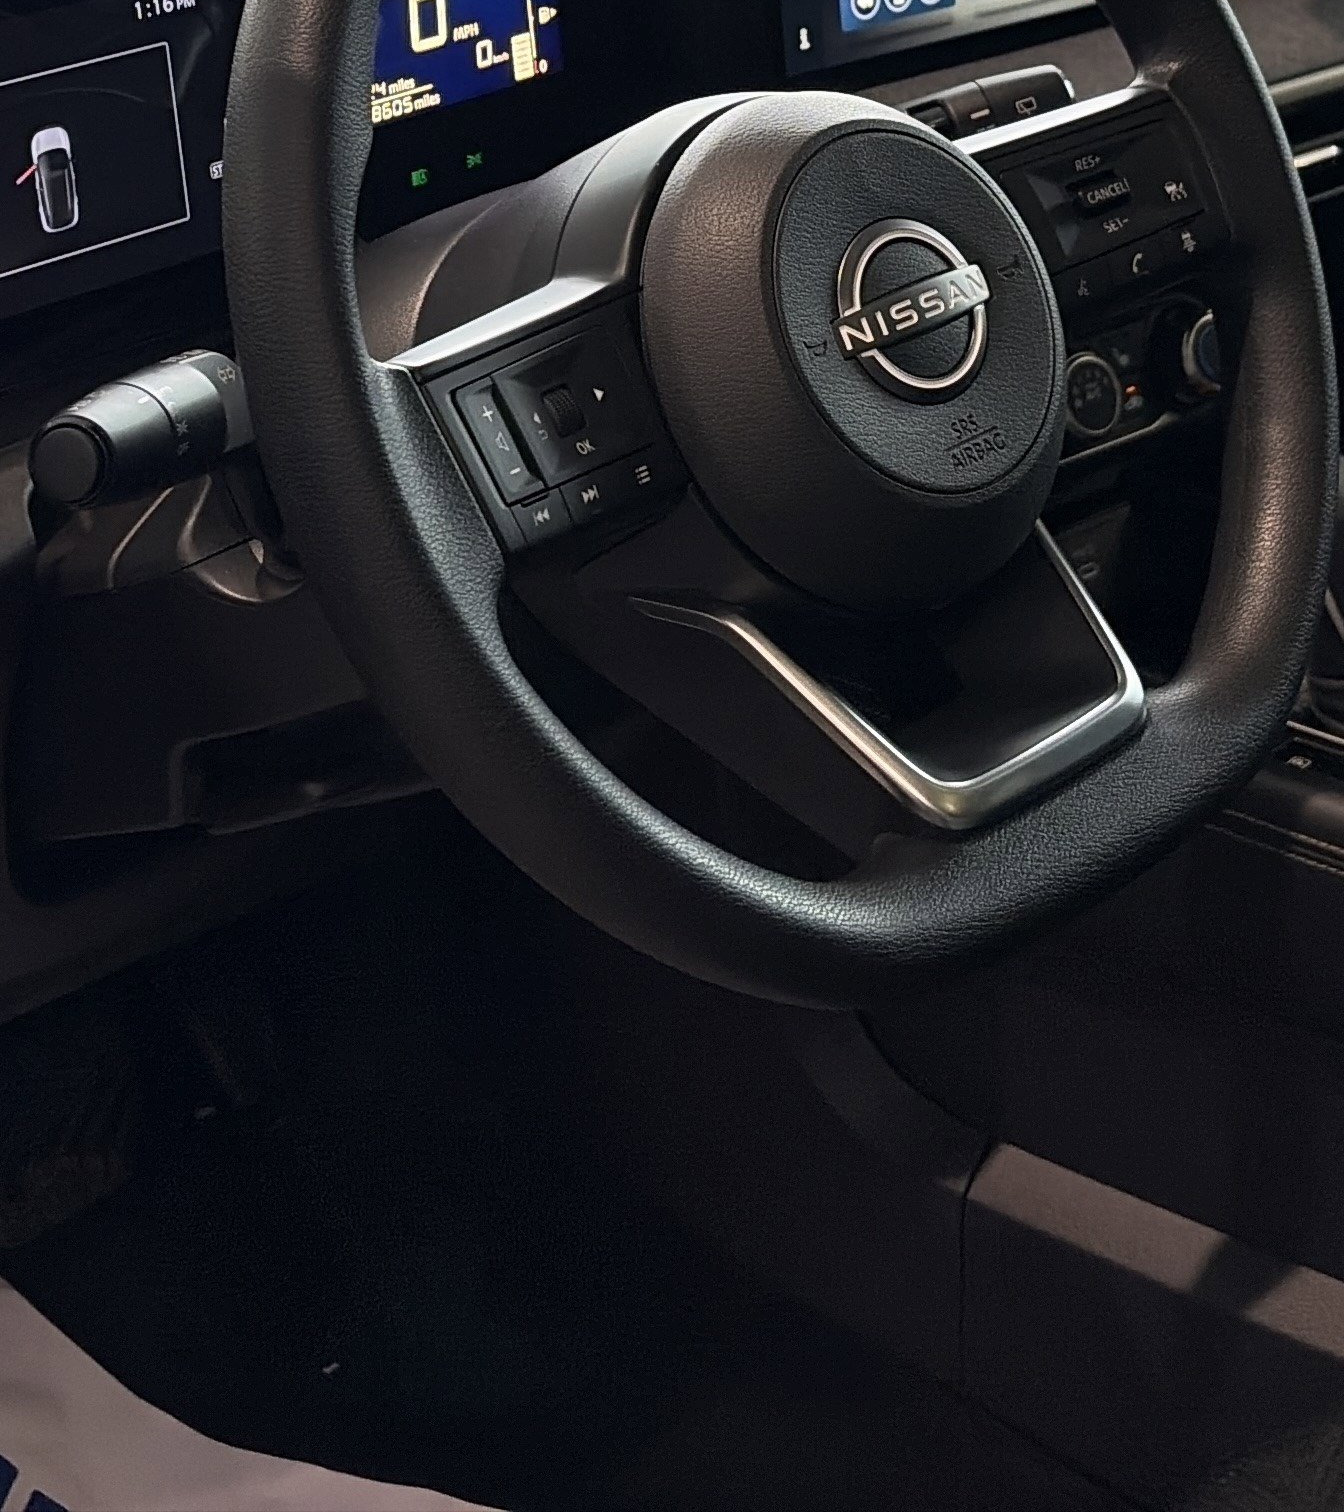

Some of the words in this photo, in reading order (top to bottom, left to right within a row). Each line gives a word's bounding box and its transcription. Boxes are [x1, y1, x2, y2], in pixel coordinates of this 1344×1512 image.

[453, 22, 479, 42] MPH
[476, 39, 493, 70] 0
[388, 77, 416, 95] miles
[414, 93, 441, 111] miles
[1086, 179, 1128, 204] CANCEL
[838, 269, 989, 351] NISSAN
[950, 412, 979, 439] SRS
[575, 438, 596, 455] OK
[950, 431, 1006, 470] AIRBAG
